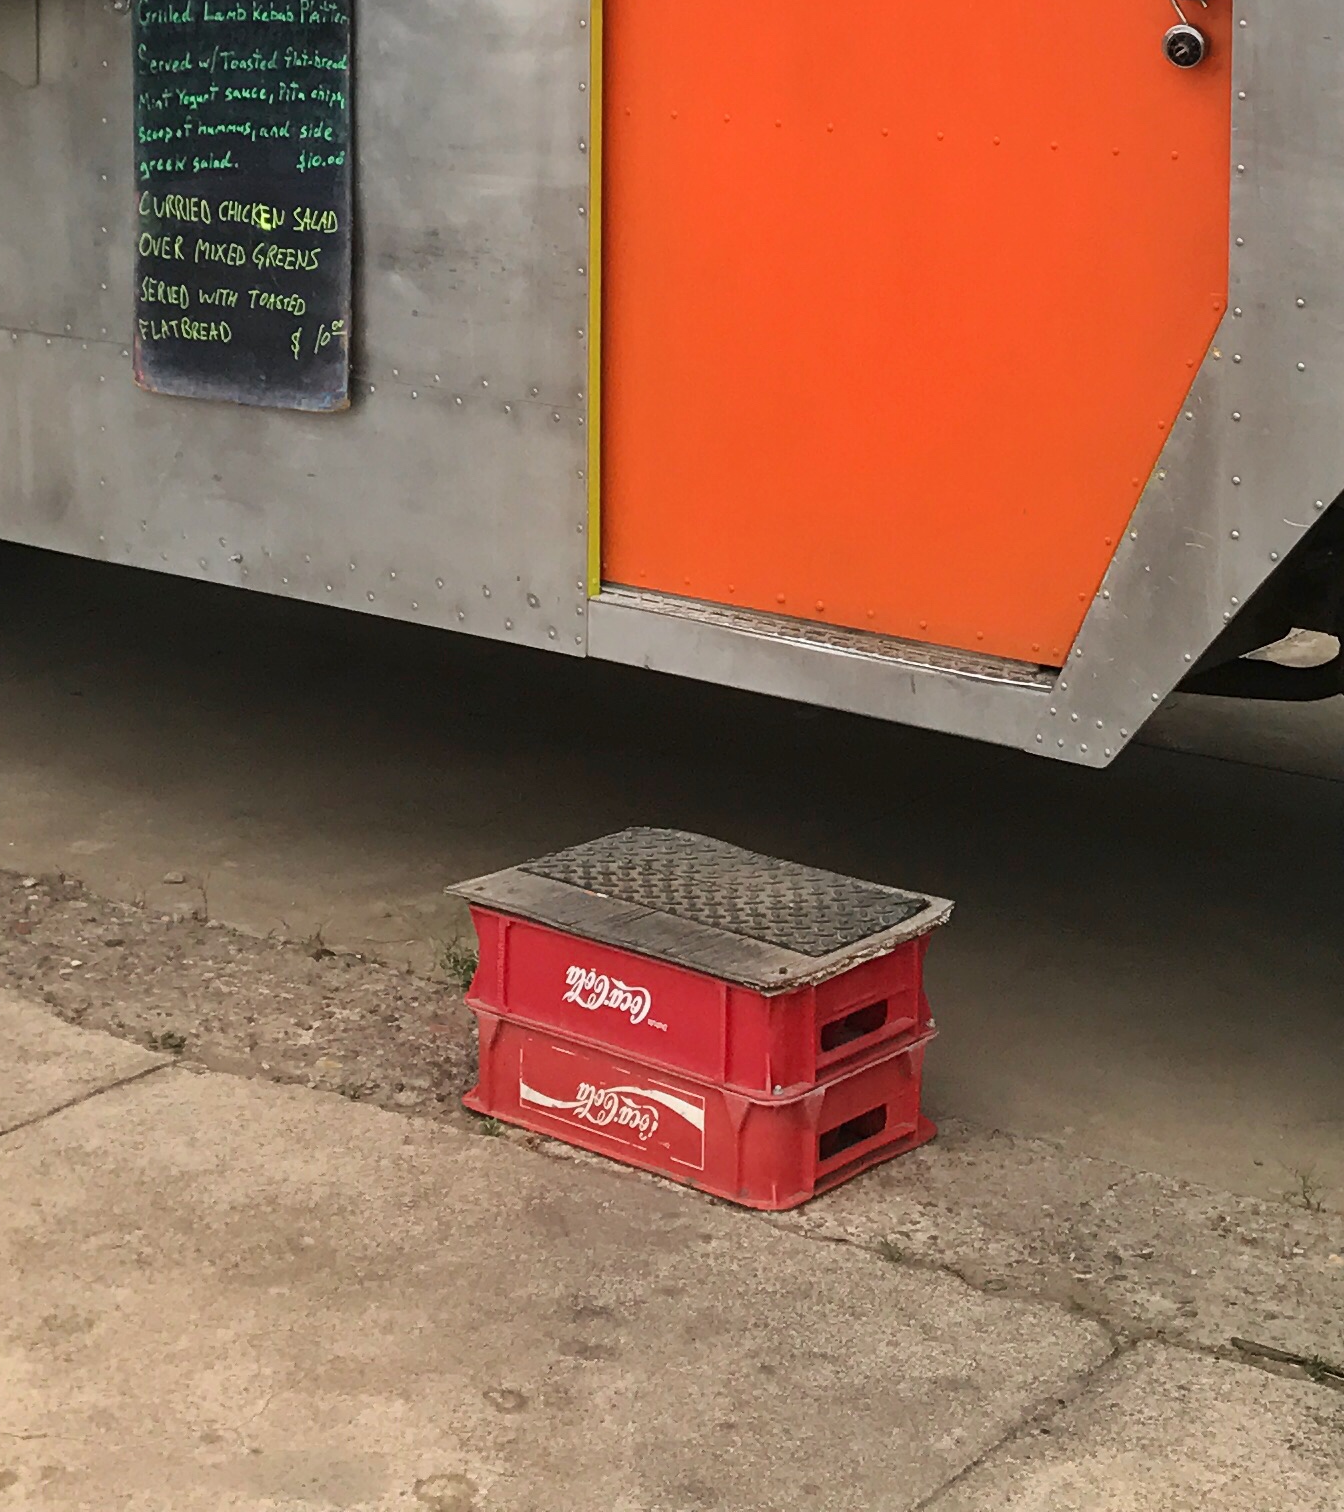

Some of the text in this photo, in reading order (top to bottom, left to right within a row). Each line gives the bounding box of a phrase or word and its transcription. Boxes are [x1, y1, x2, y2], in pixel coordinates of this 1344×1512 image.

[137, 43, 192, 75] Served
[138, 88, 172, 111] Mint
[176, 82, 219, 109] Yogurt
[259, 120, 290, 139] and
[299, 120, 333, 141] side
[138, 190, 339, 234] CURRIED CHICKEN SALAD
[138, 232, 323, 271] OVER MIXED GREENS
[198, 288, 239, 308] WITH
[248, 289, 307, 316] TOASTED
[138, 316, 233, 343] FLATBREAD
[561, 964, 652, 1025] Coca-Cola
[572, 1081, 660, 1141] Coca-Cola
